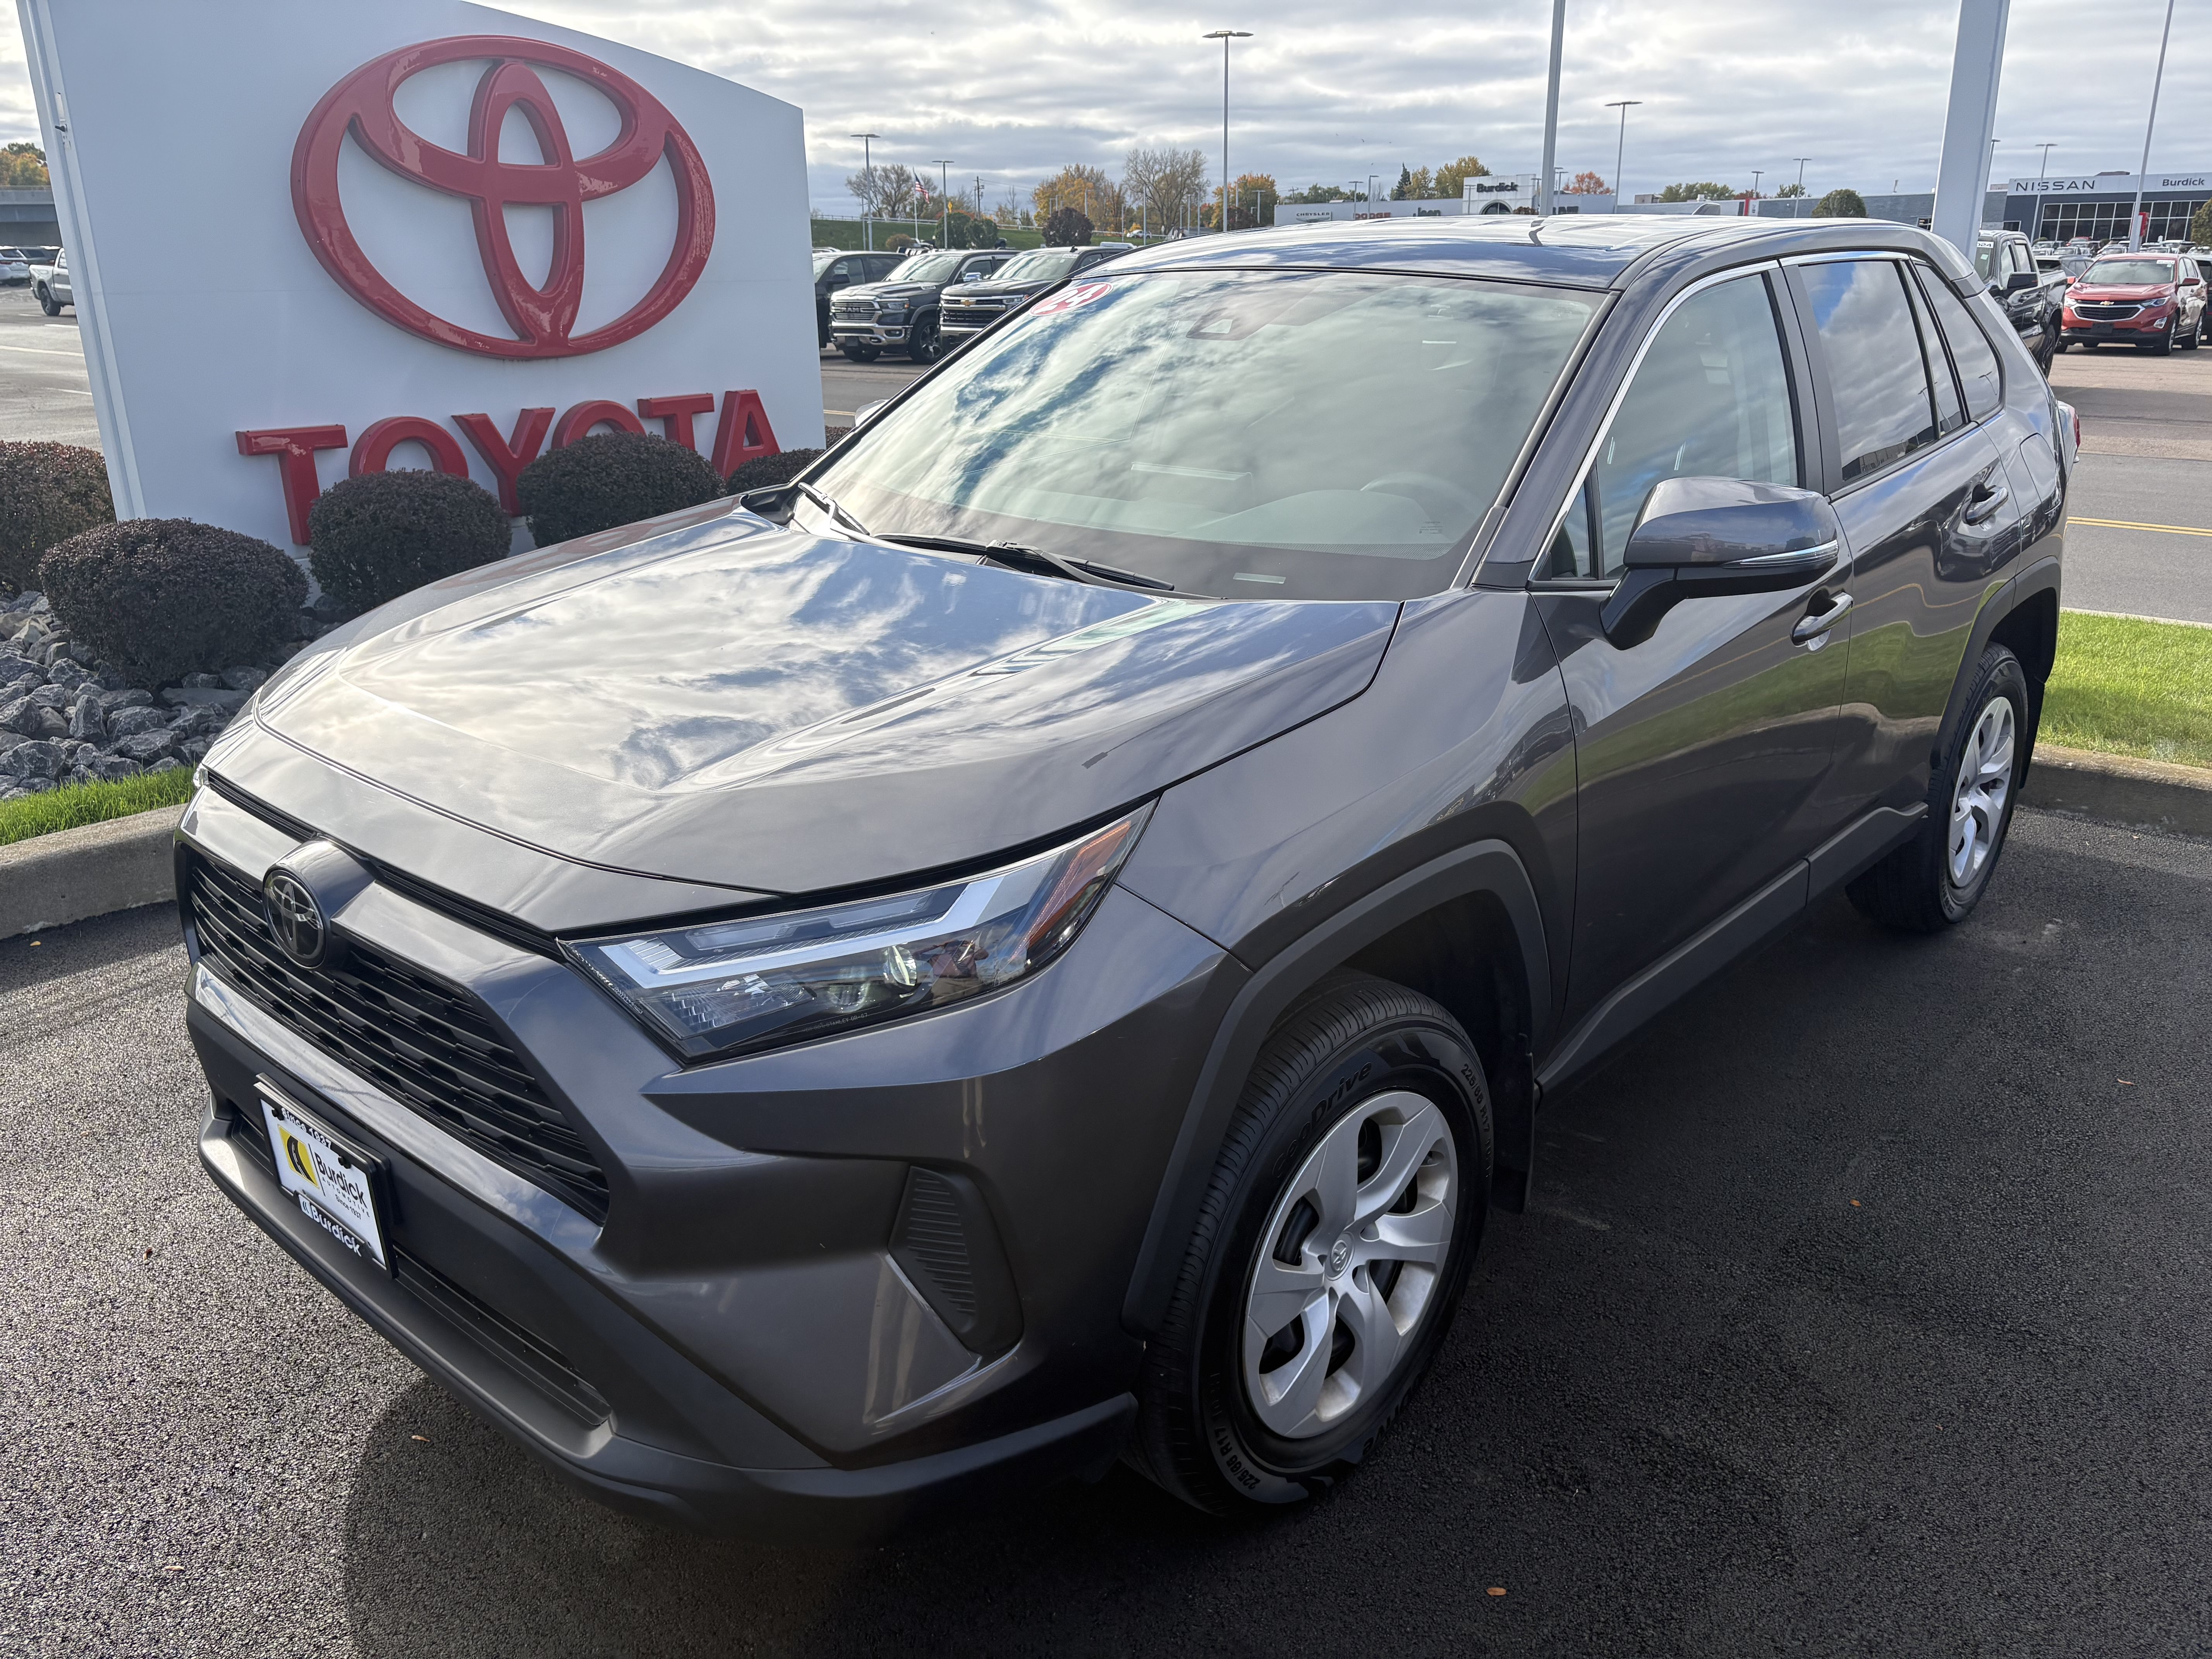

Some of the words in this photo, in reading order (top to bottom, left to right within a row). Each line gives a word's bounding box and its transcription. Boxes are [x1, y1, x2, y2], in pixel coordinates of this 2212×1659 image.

[1477, 182, 1518, 192] Burdick
[2016, 180, 2095, 191] NISSAN
[2162, 178, 2205, 186] Burdick
[281, 1107, 307, 1132] Since
[309, 1128, 332, 1149] 1937
[315, 1152, 368, 1209] Burdick
[322, 1176, 370, 1218] AUTOMOTIVE
[349, 1206, 361, 1220] 1937
[311, 1205, 362, 1257] Burdick
